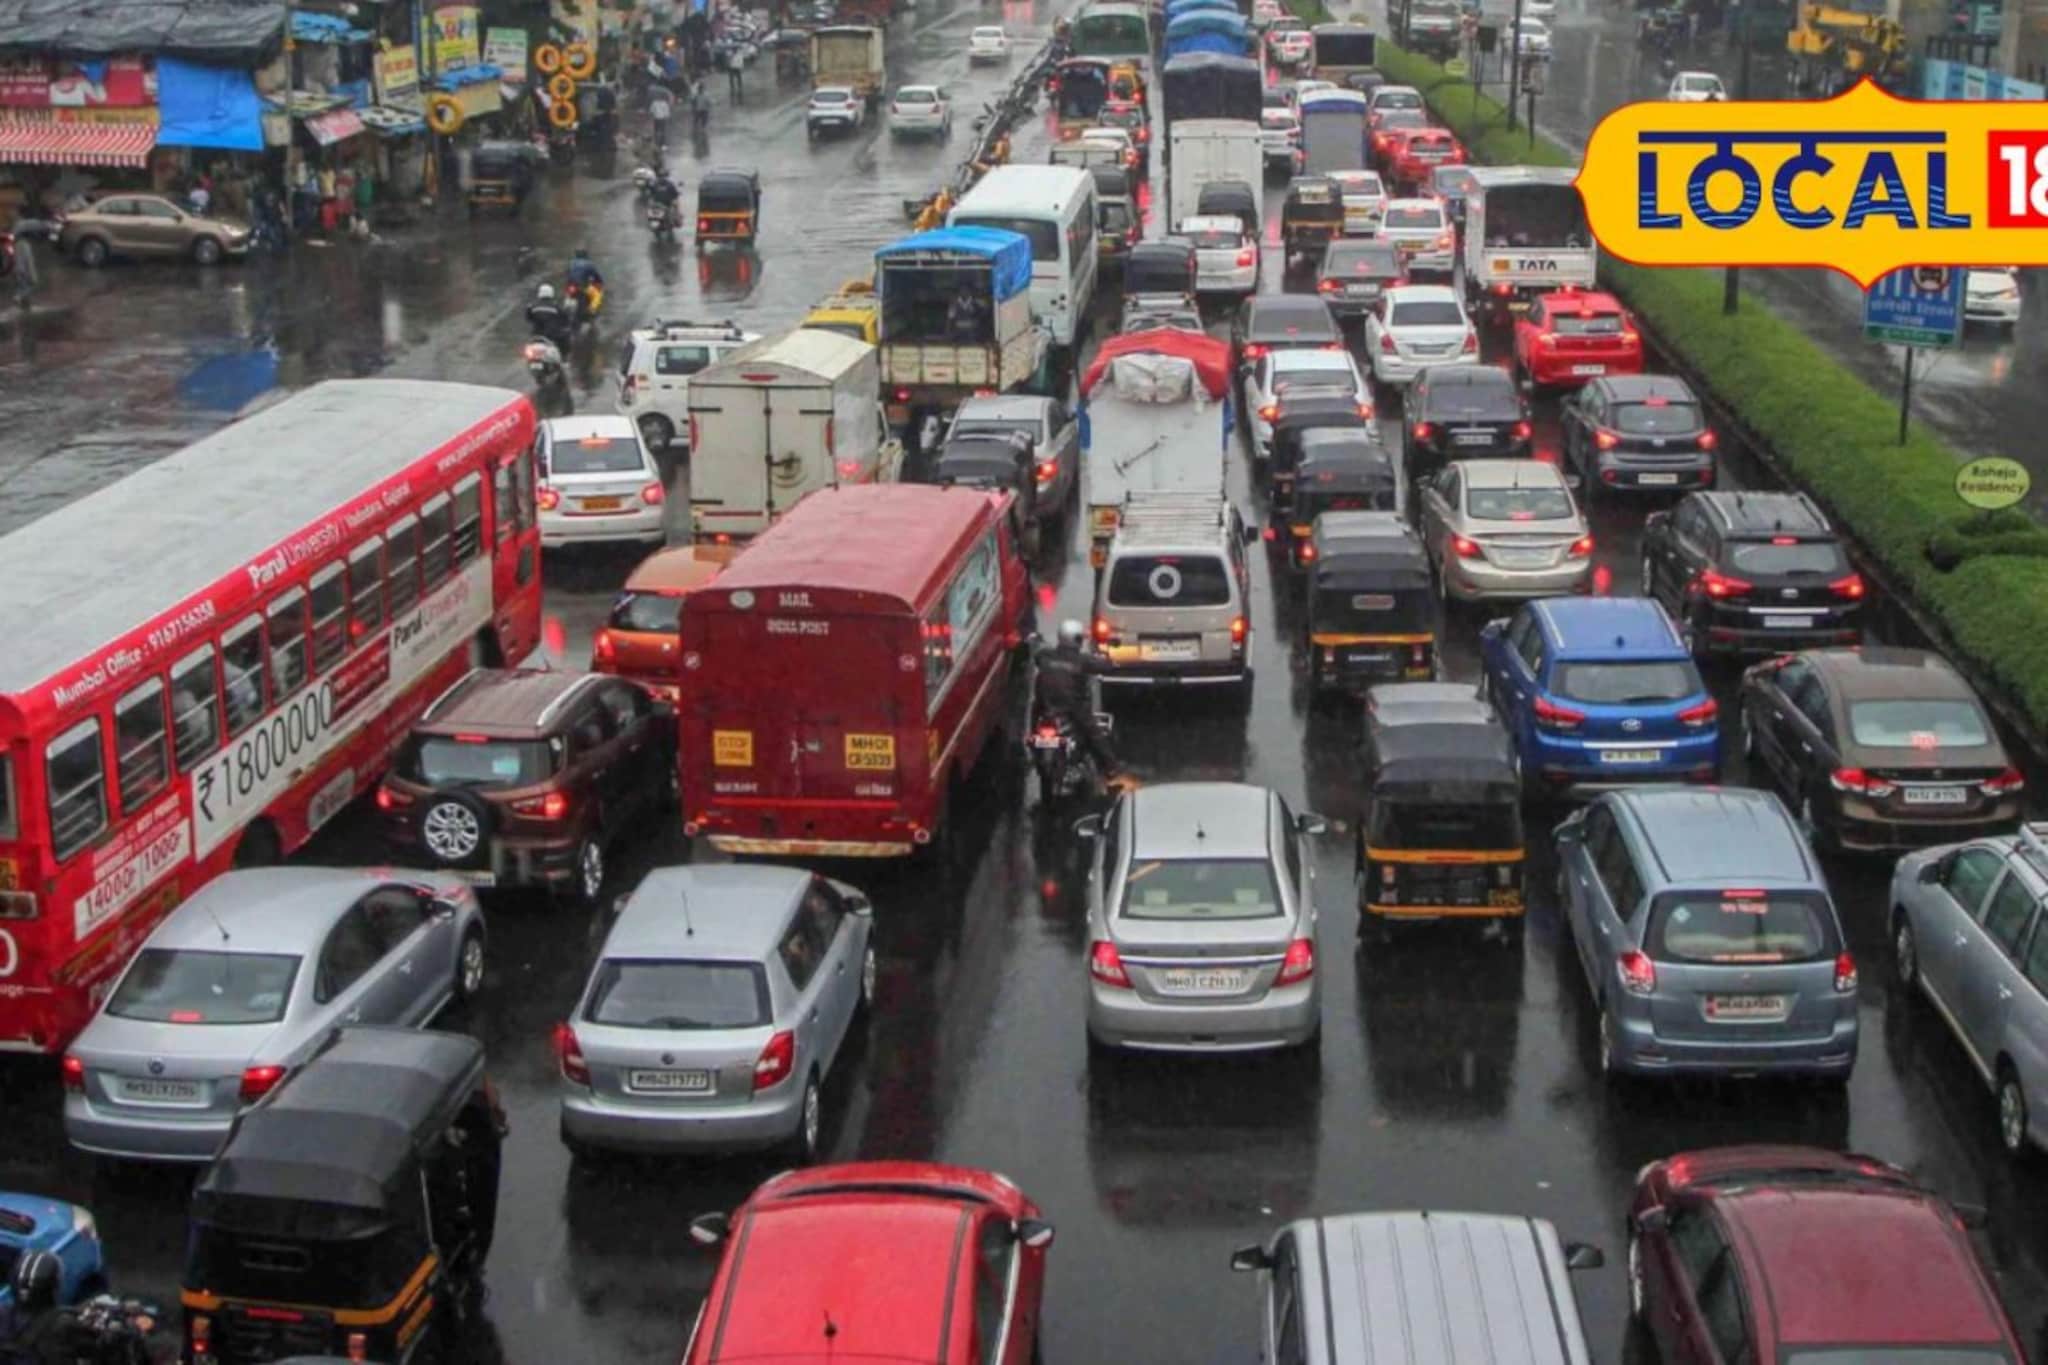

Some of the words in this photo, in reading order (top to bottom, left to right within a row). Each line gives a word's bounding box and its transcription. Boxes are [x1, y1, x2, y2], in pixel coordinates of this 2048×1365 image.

[1518, 259, 1557, 271] TATA
[248, 550, 288, 589] Parul
[52, 664, 107, 709] Mumbai
[106, 648, 142, 676] Office
